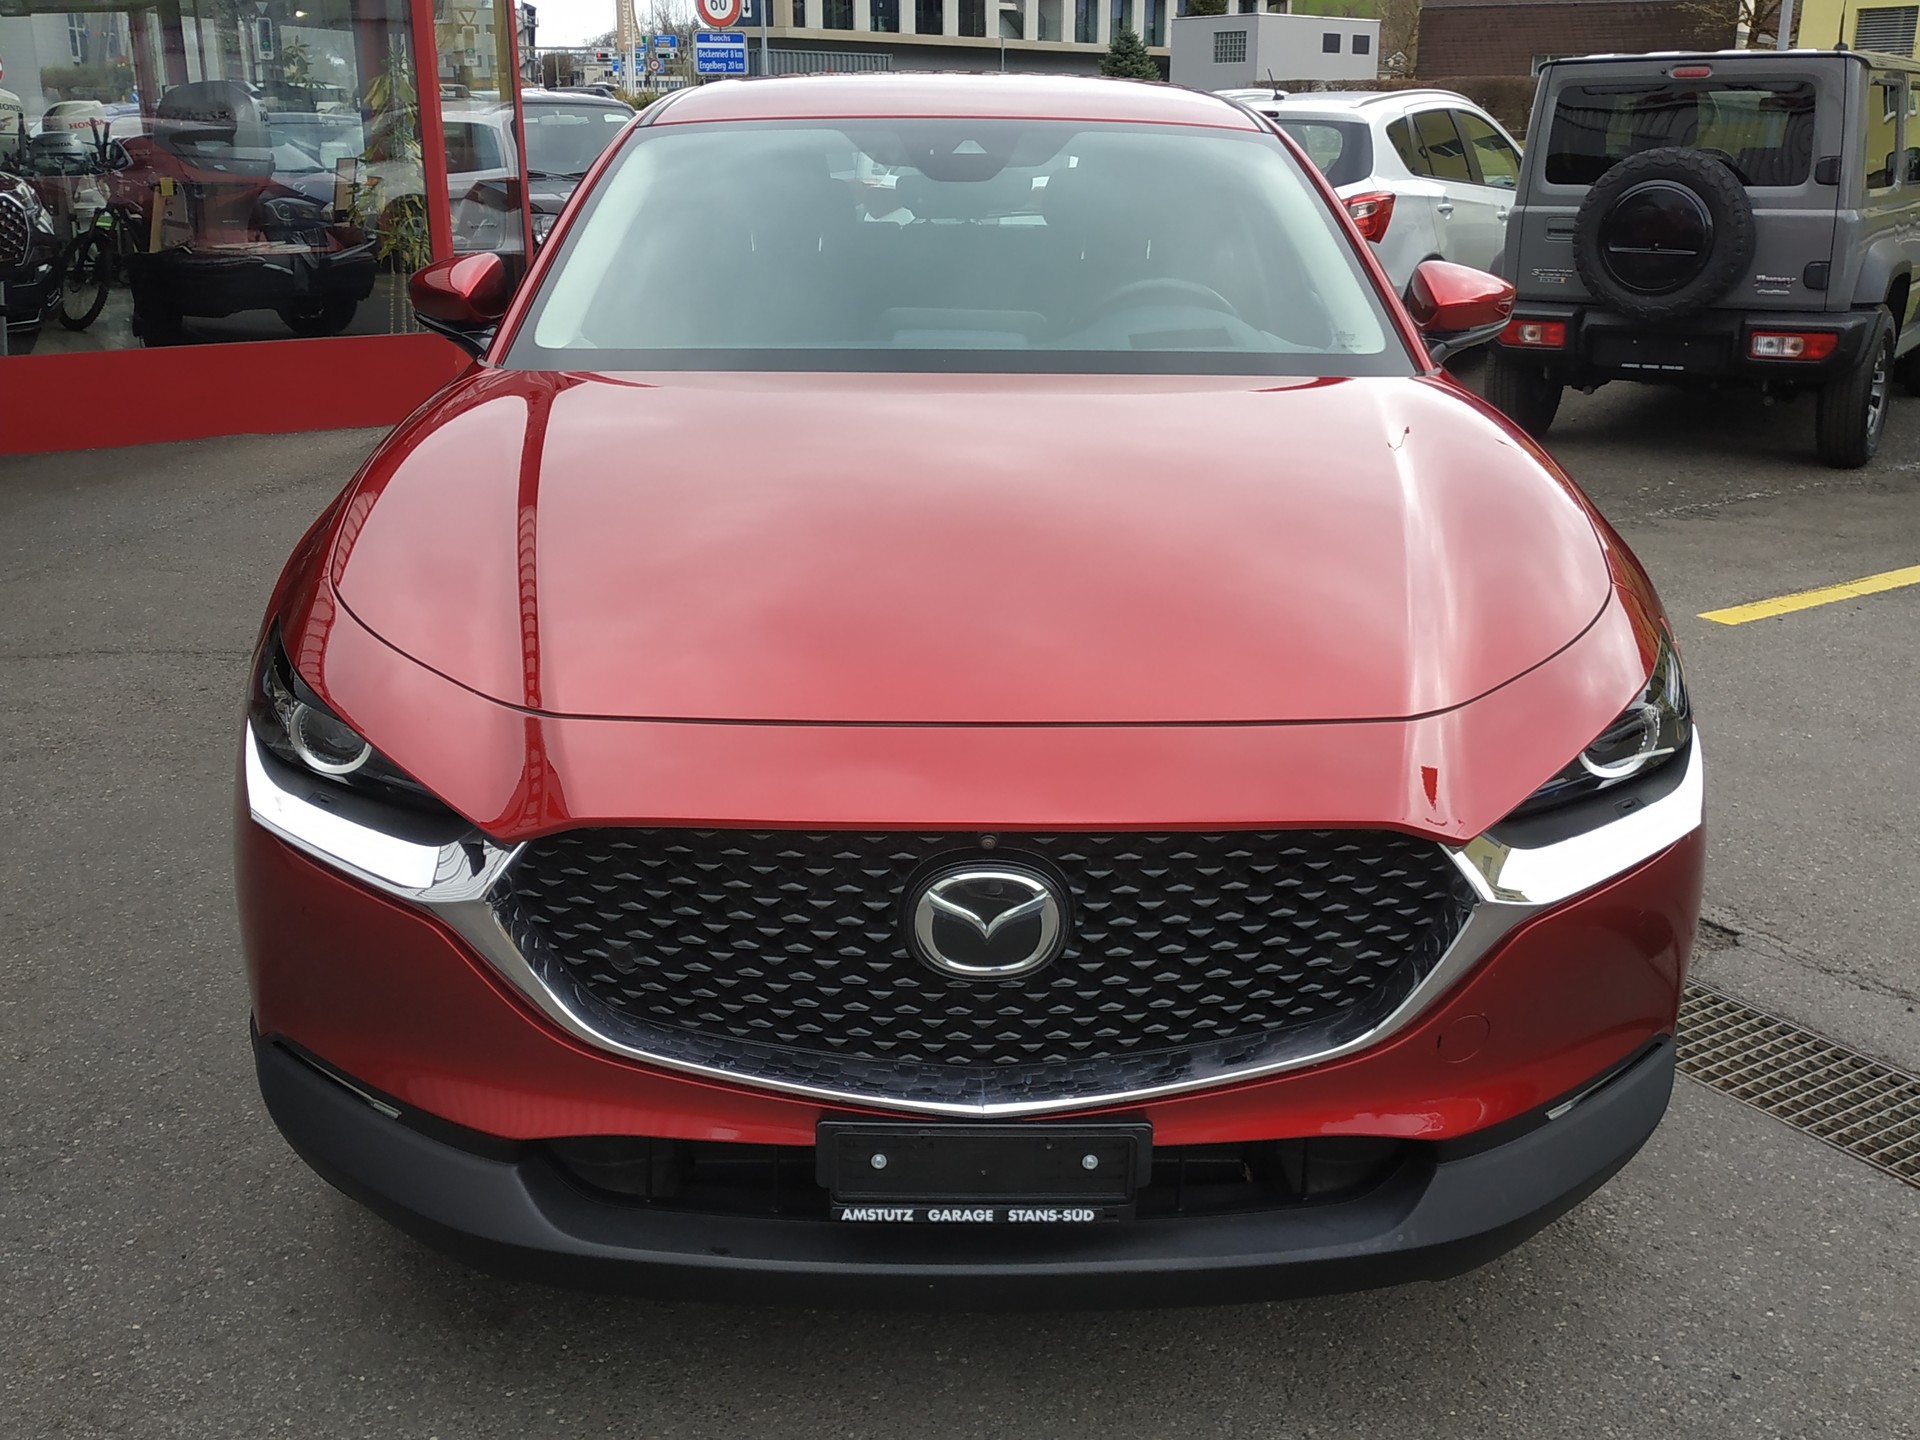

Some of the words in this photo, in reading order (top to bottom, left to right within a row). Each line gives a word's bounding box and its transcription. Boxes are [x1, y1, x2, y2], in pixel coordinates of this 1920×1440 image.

[709, 34, 731, 42] Buochs
[698, 49, 729, 58] Beckenried
[730, 49, 735, 58] 8
[735, 49, 744, 58] km
[699, 60, 727, 72] Engelberg
[728, 60, 735, 70] 20
[735, 60, 744, 70] km
[841, 1208, 914, 1222] AMSTUTZ
[927, 1208, 994, 1222] GARAGE
[1007, 1208, 1095, 1222] STANS-SÜD
